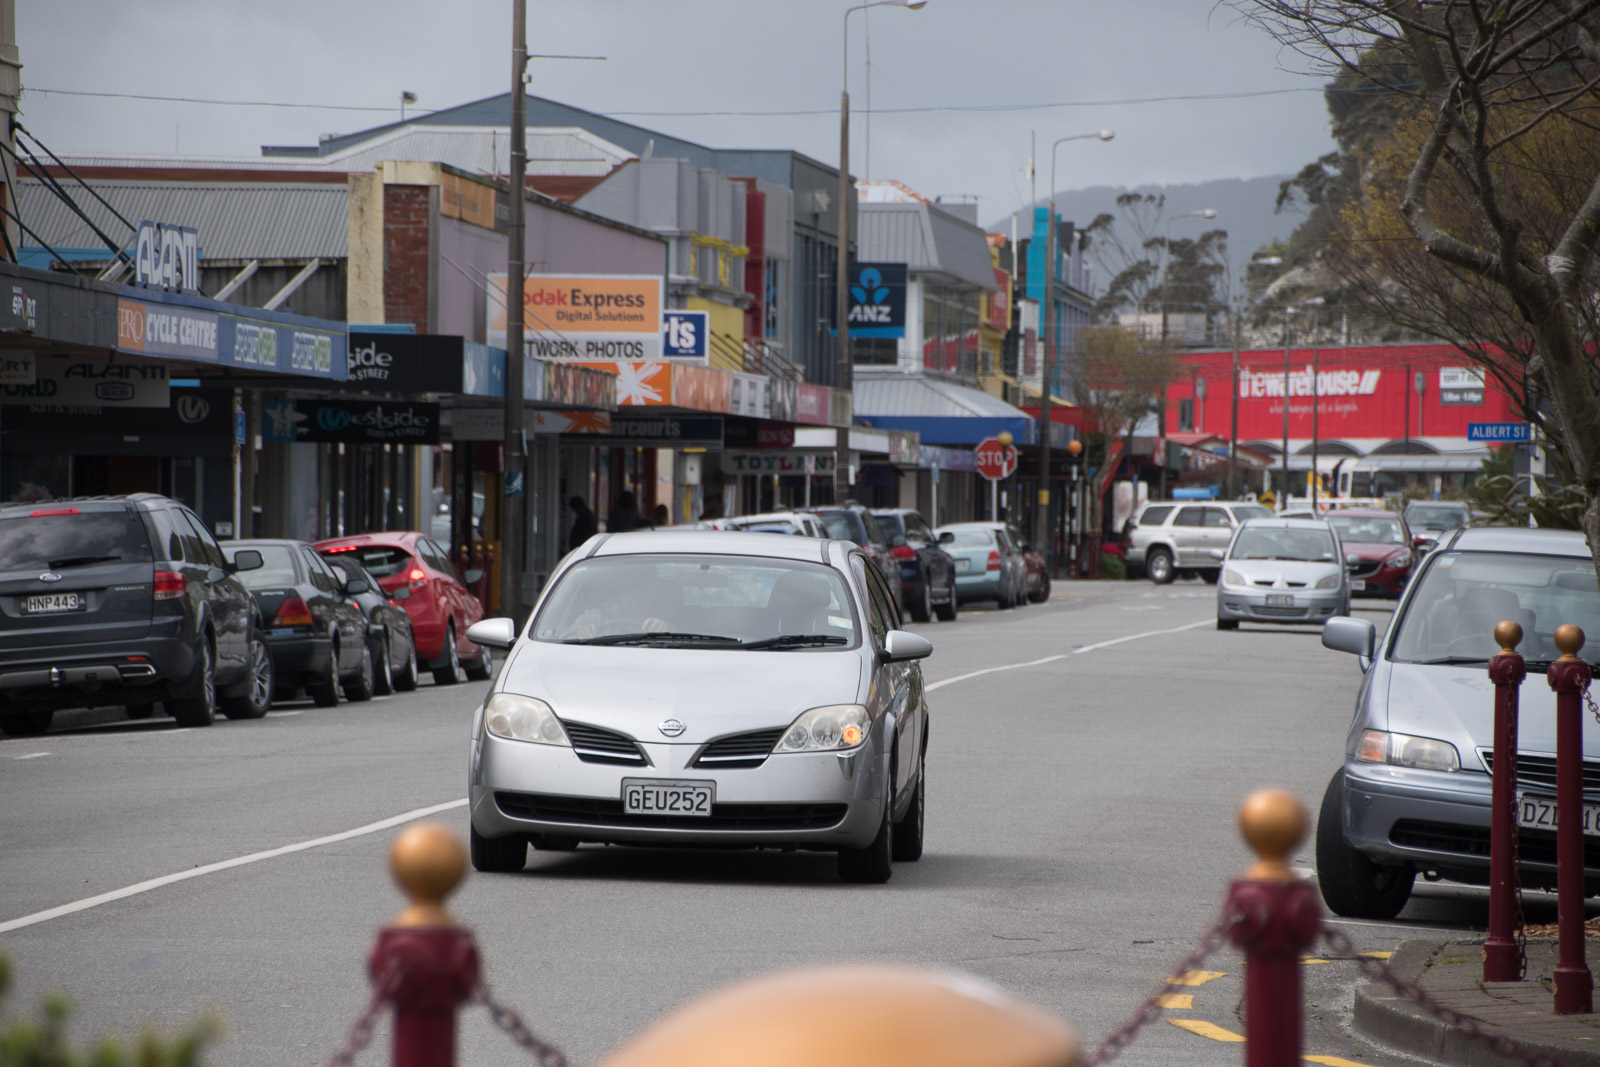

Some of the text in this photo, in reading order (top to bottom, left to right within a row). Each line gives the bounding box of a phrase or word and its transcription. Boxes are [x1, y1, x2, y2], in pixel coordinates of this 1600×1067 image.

[136, 220, 198, 293] AVANTI
[507, 289, 645, 310] odak Express
[557, 310, 645, 322] Digital Solutions
[848, 305, 892, 322] ANZ
[118, 308, 144, 343] PRO
[146, 312, 178, 344] CYCLE
[179, 316, 217, 349] CENTRE
[586, 342, 643, 358] PHOTOS
[65, 363, 166, 380] AVANTI
[357, 368, 390, 380] STREET
[0, 379, 57, 397] ORLD
[1472, 426, 1526, 438] ALBERT ST
[28, 595, 77, 610] HNP443
[628, 790, 708, 812] GEU252
